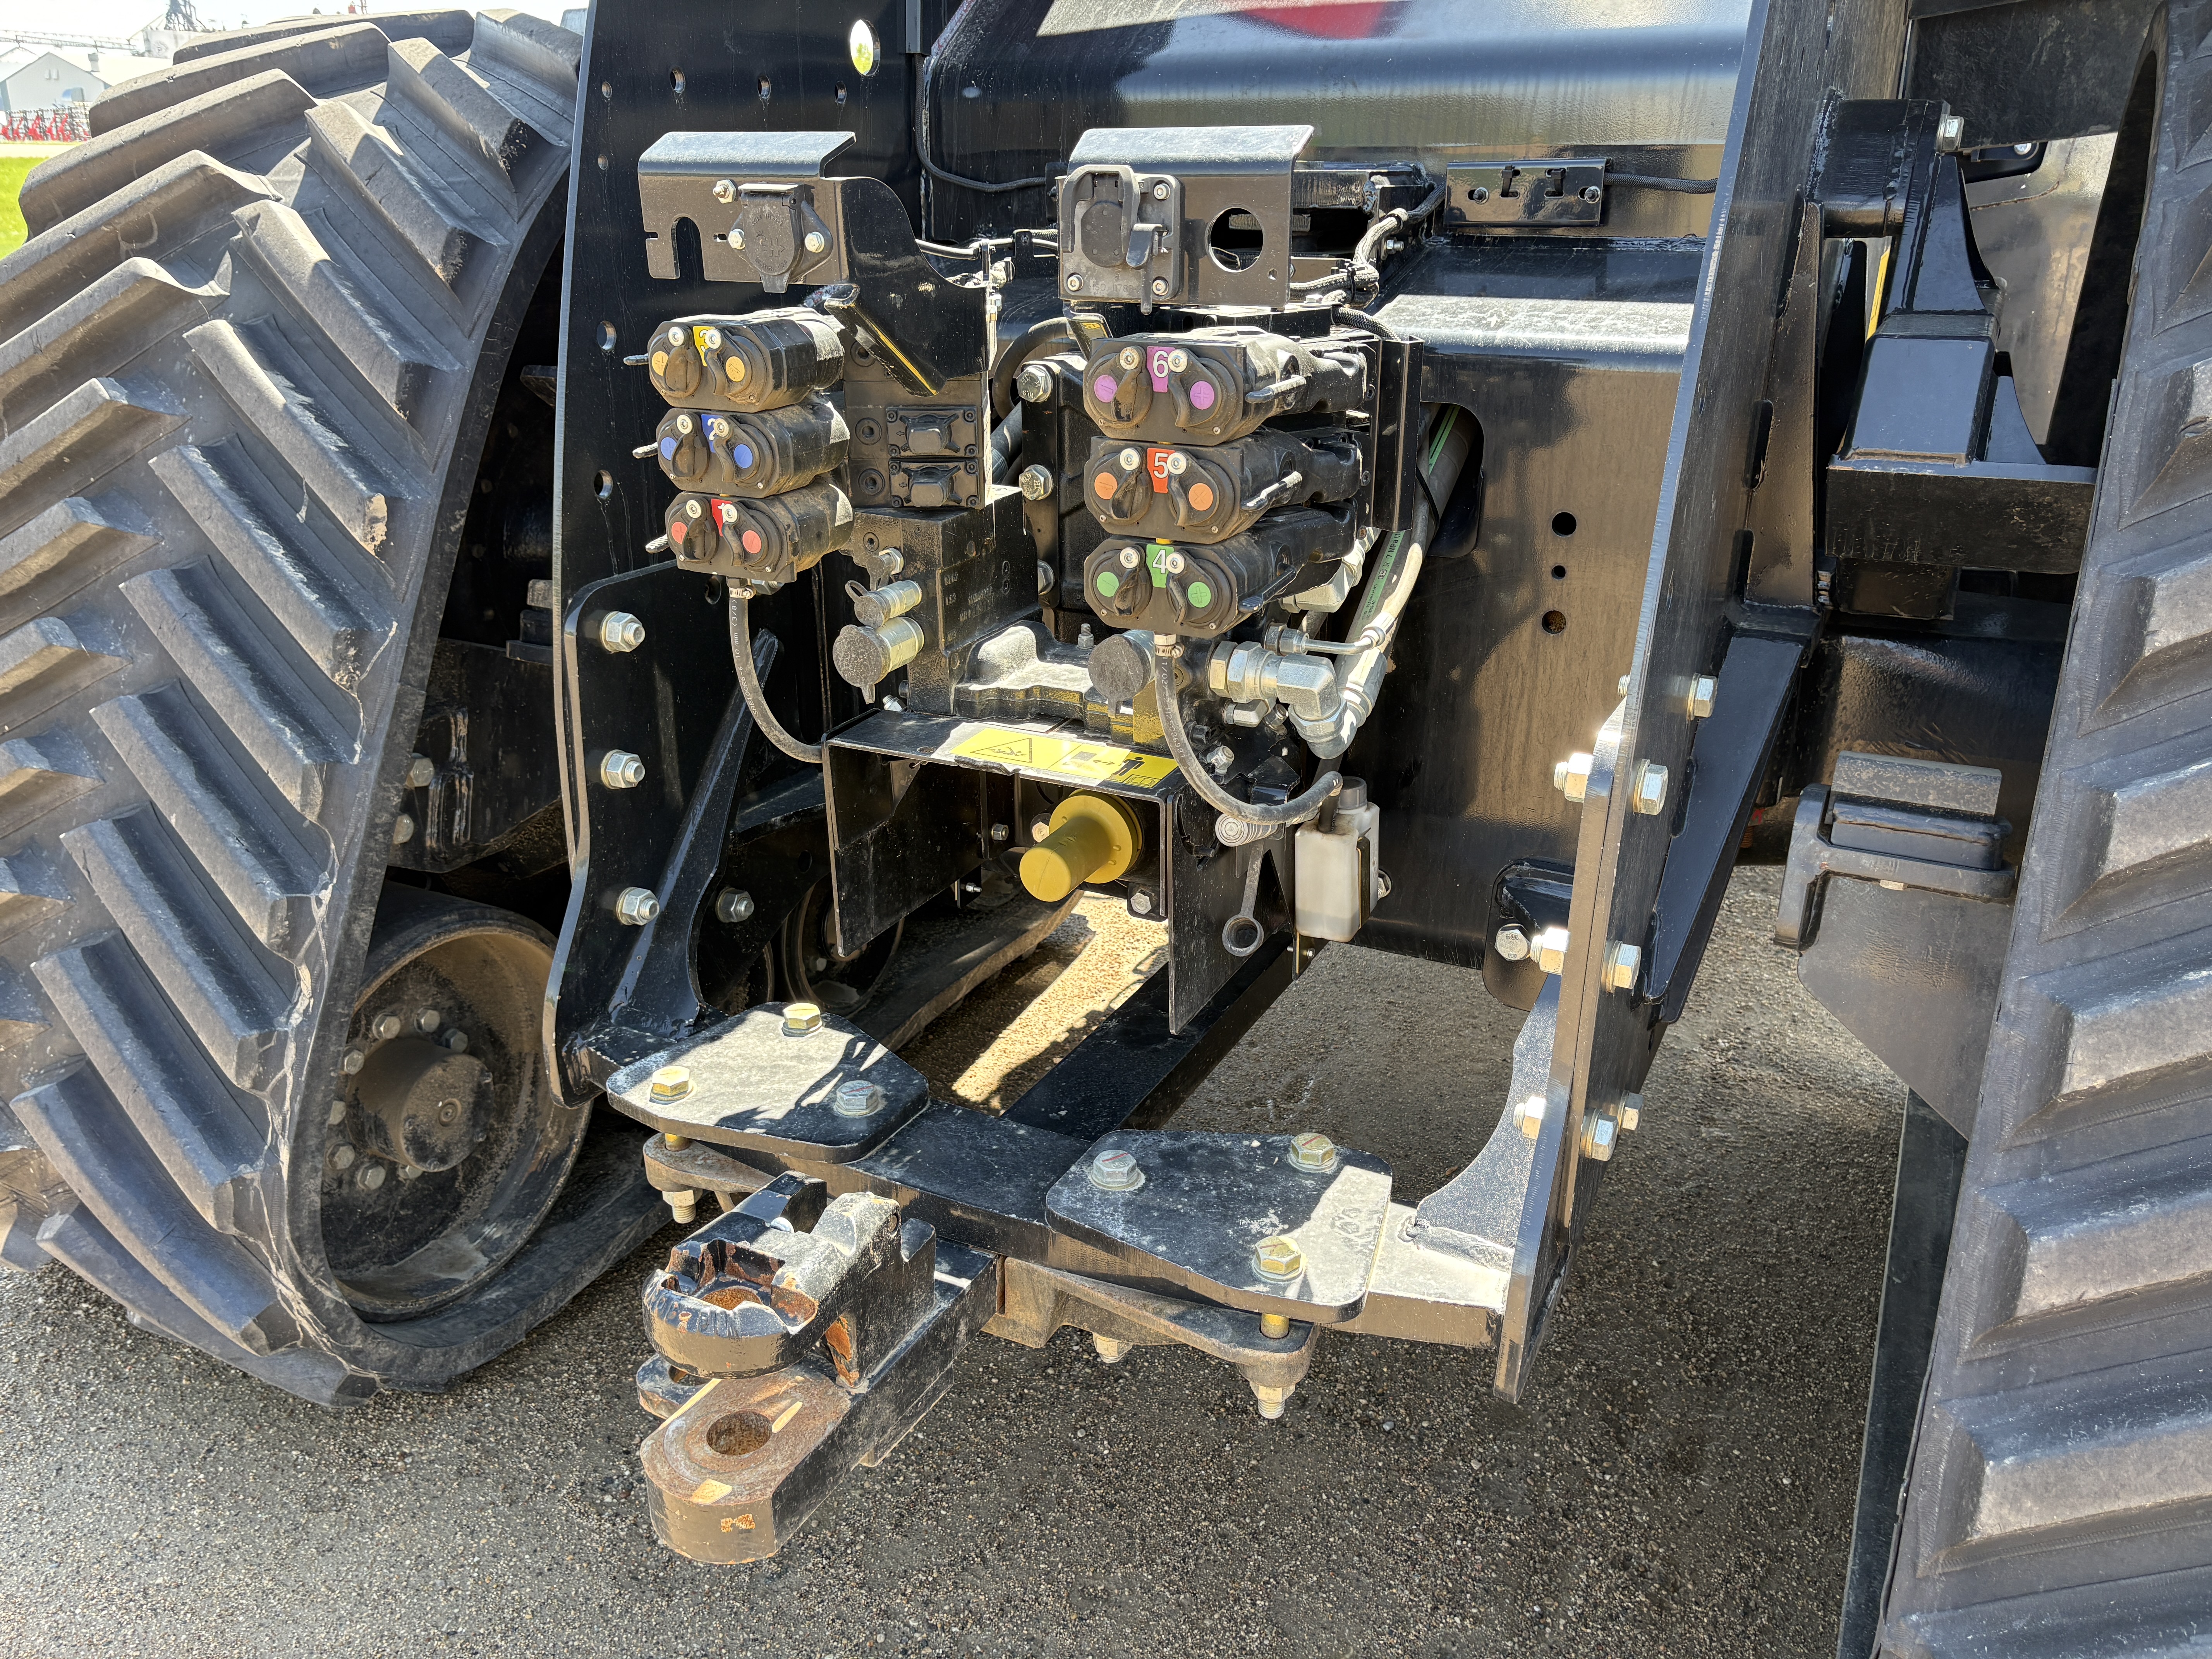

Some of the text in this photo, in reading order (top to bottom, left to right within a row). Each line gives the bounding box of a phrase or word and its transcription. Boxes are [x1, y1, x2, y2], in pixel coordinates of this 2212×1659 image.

[1153, 350, 1169, 378] 6
[1153, 452, 1169, 479] 5
[1388, 539, 1399, 553] MPa
[1152, 549, 1168, 574] 4
